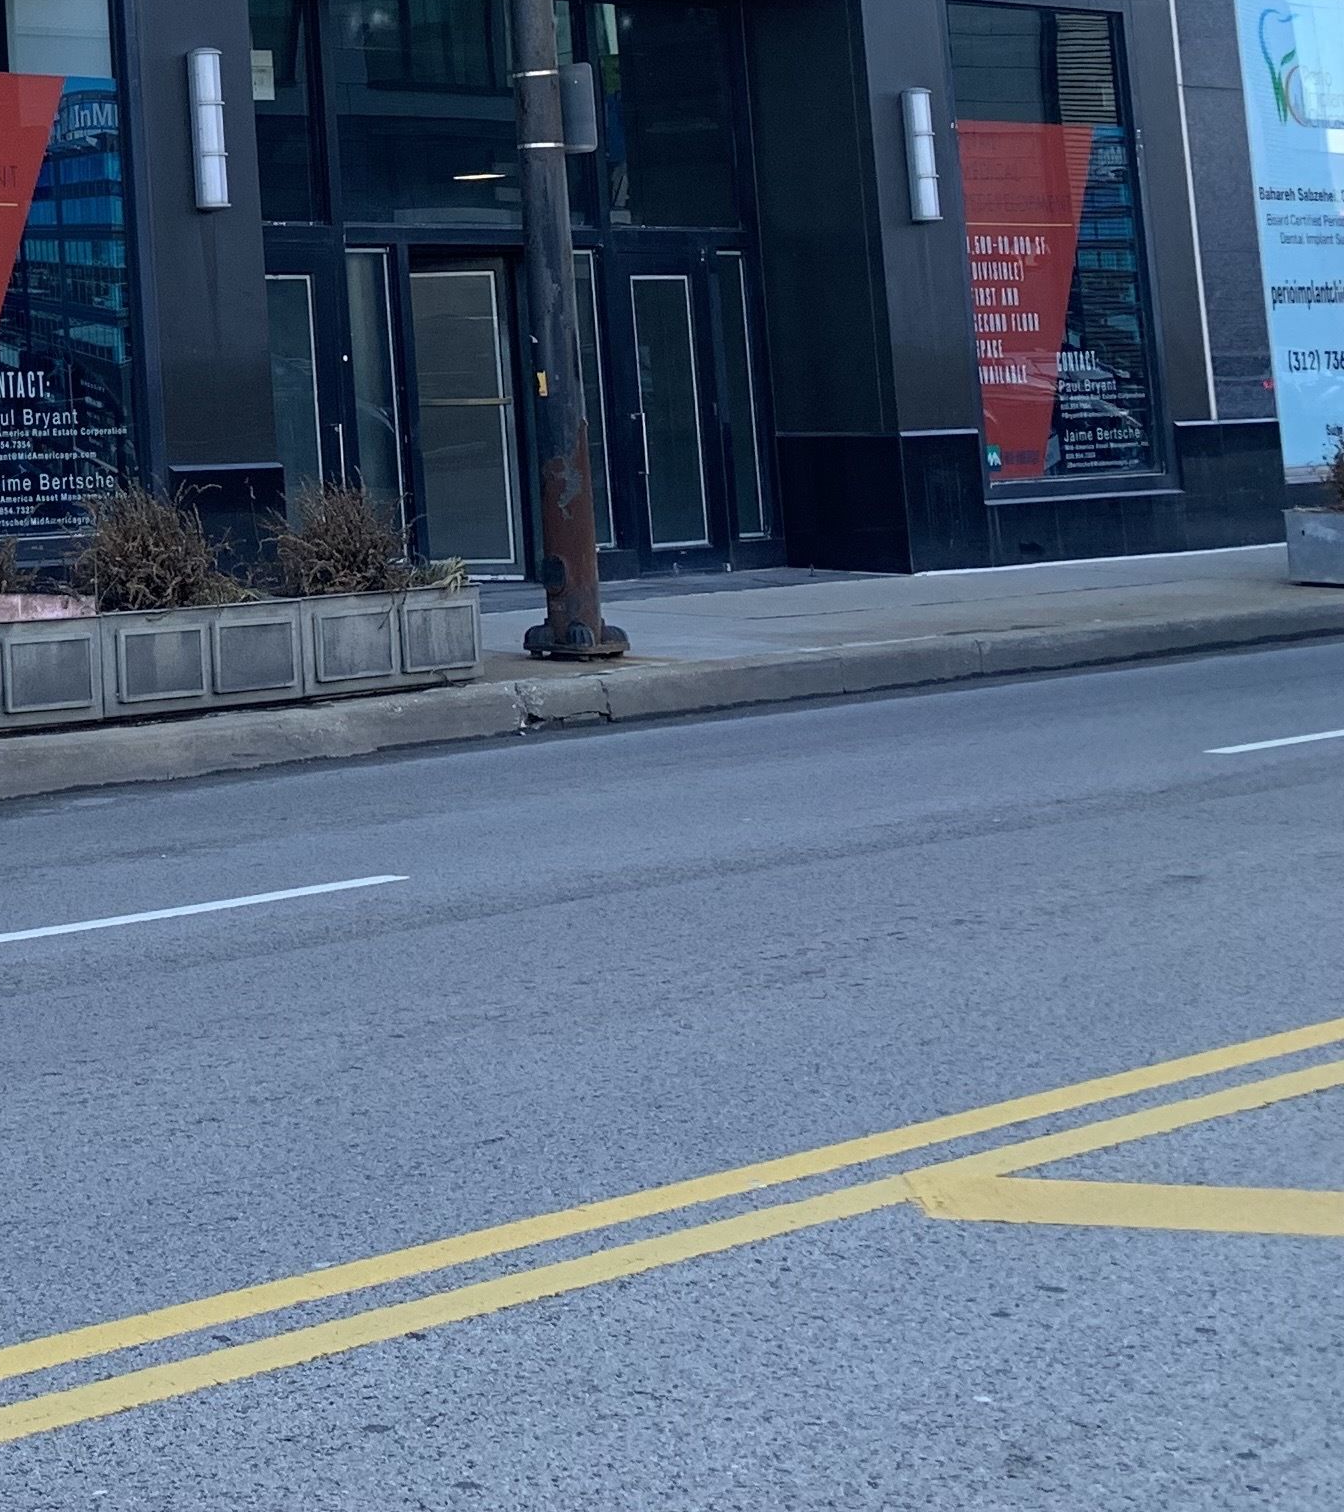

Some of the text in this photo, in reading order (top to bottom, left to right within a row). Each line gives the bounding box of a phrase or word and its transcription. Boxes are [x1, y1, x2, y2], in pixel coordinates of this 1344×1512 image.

[1258, 186, 1296, 201] Bahareh
[1001, 287, 1019, 306] AND
[1011, 312, 1040, 331] FLOOR
[1288, 349, 1321, 373] (312)
[1058, 378, 1117, 394] Paul Bryant
[22, 408, 79, 429] Bryant
[32, 428, 50, 437] Real
[52, 428, 78, 437] Estate
[80, 427, 128, 437] Corporation
[1064, 426, 1141, 442] Jaime Bertsche
[39, 472, 114, 491] Bertsche
[35, 494, 59, 502] Asset
